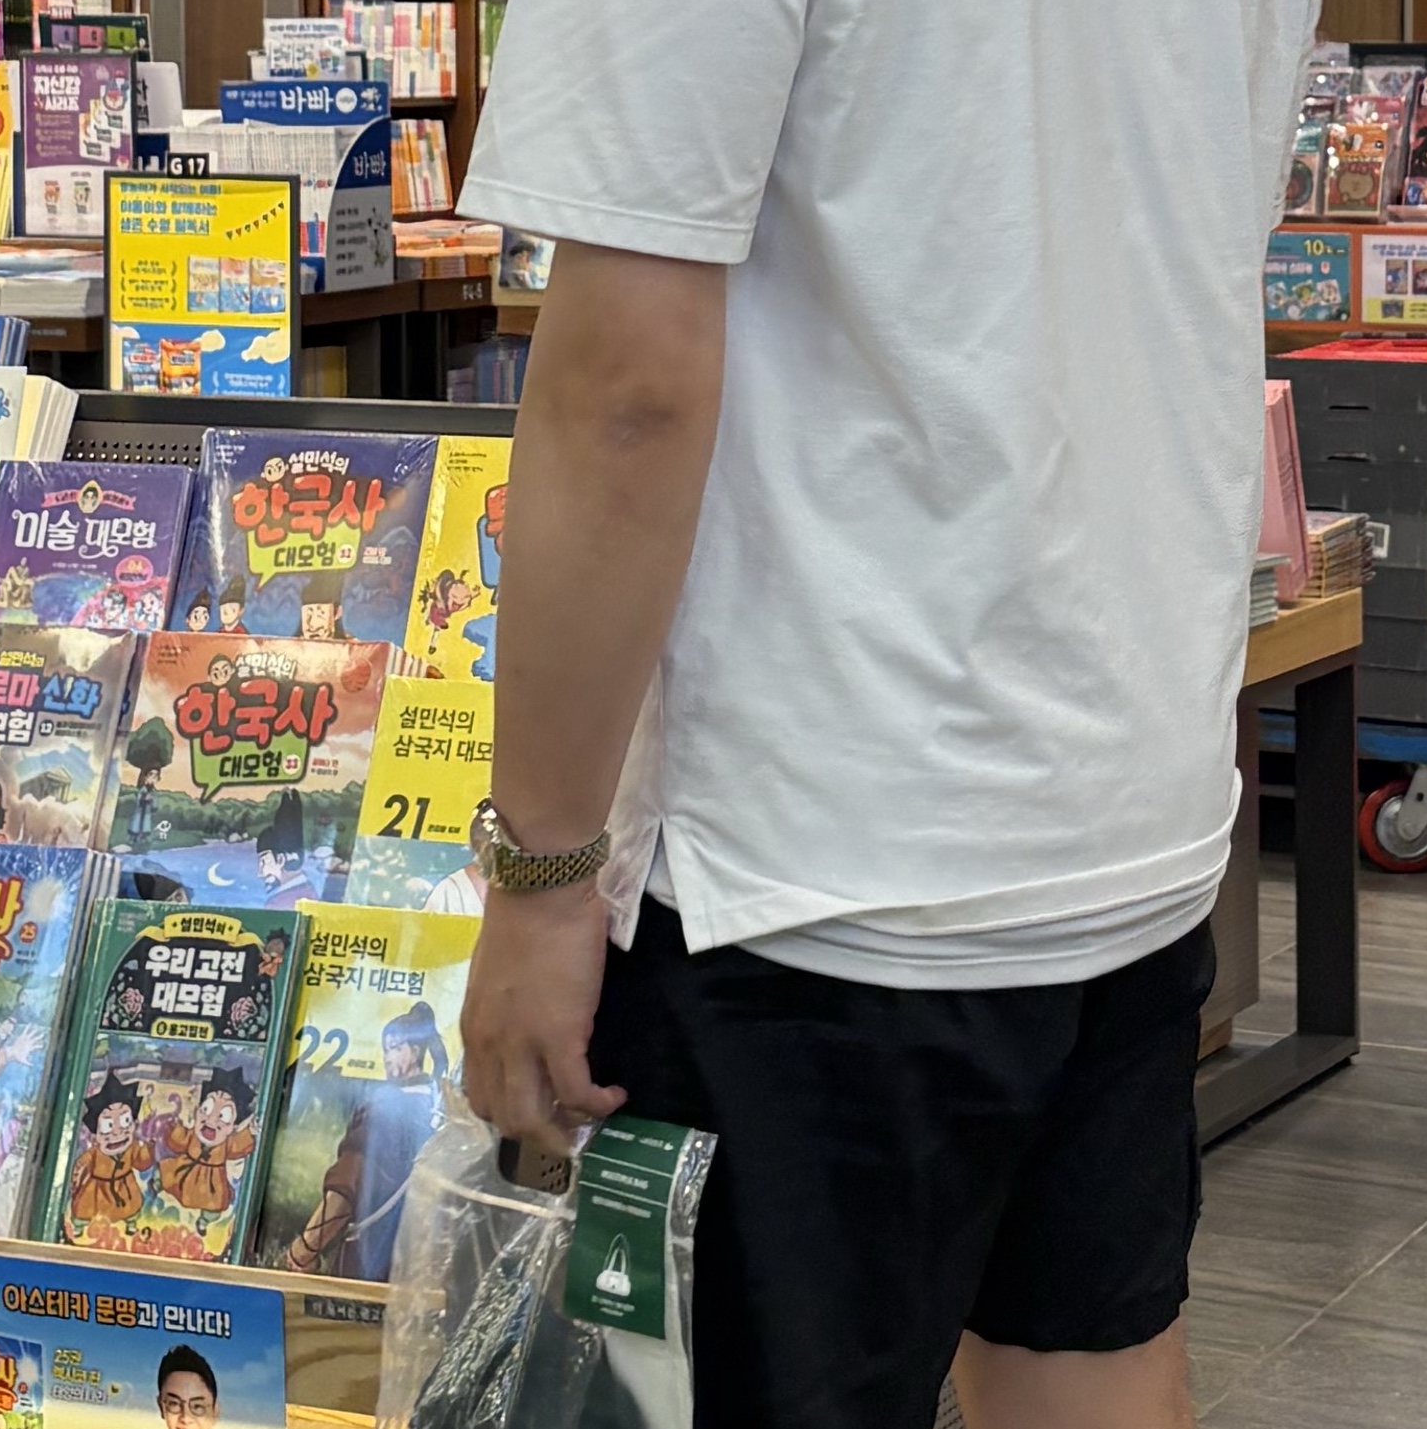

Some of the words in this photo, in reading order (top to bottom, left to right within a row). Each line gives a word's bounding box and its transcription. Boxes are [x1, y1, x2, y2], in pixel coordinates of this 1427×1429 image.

[279, 85, 335, 115] 바빠
[171, 158, 183, 178] G
[188, 156, 206, 176] 17
[353, 150, 387, 180] 바빠
[287, 449, 351, 476] 설민석의
[231, 473, 386, 545] 한국사
[11, 508, 81, 552] 미술
[78, 517, 158, 560] 대모험
[272, 543, 337, 570] 대모험
[235, 652, 298, 681] 설민석의
[41, 672, 103, 720] 신화
[174, 679, 337, 754] 한국사
[398, 705, 477, 735] 설민석의
[392, 734, 452, 763] 삼국지
[218, 751, 284, 780] 대모험
[376, 793, 432, 840] 21
[179, 916, 227, 936] 설민석의
[309, 931, 389, 962] 설민석의
[144, 943, 196, 980] 우리
[193, 947, 247, 983] 고전
[303, 960, 365, 992] 삼국지
[368, 964, 427, 996] 대모험
[150, 981, 227, 1018] 대모험
[295, 1024, 350, 1073] 22
[1, 1282, 91, 1322] 아스테카
[94, 1294, 160, 1330] 문명과
[163, 1304, 233, 1339] 만나다!
